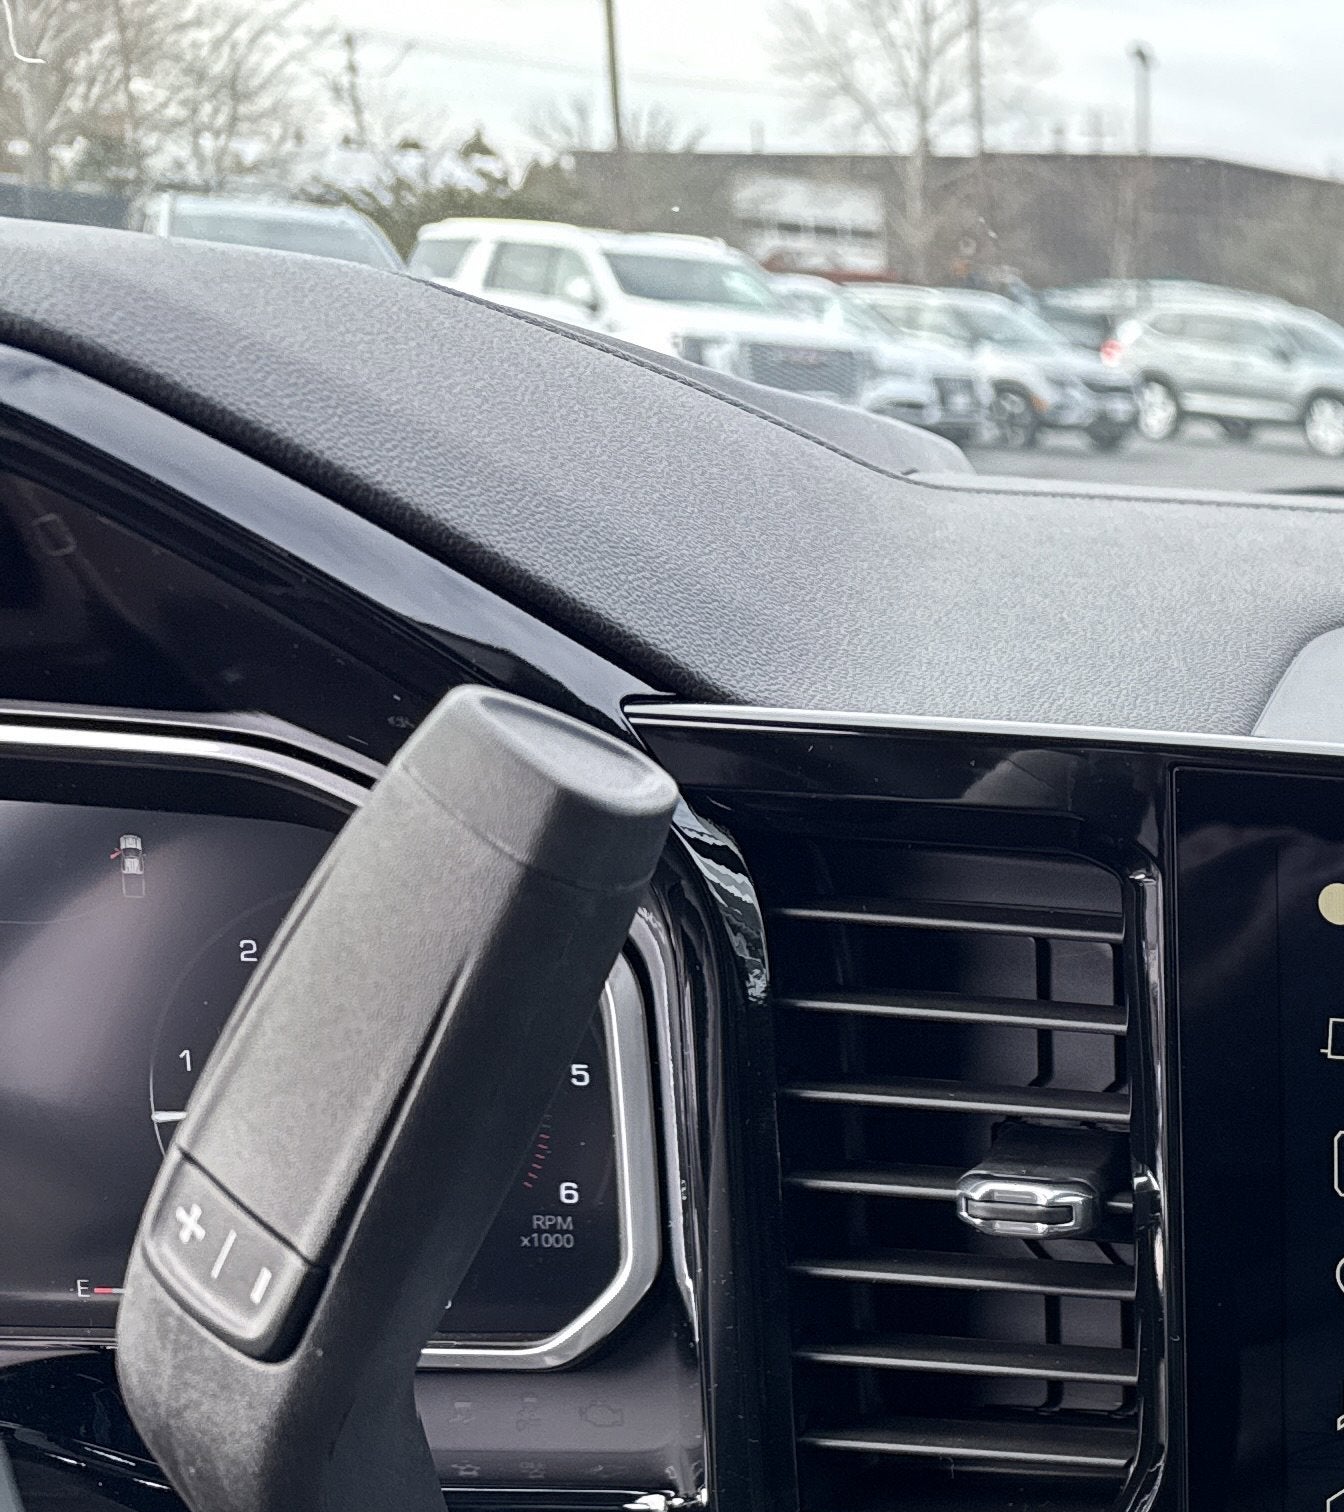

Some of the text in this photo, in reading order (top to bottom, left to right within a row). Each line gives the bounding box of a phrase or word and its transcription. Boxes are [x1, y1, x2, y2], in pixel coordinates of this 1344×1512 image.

[238, 939, 258, 962] 2
[178, 1049, 192, 1072] 1
[570, 1063, 590, 1087] 5
[559, 1181, 579, 1204] 6
[532, 1214, 574, 1231] RPM
[520, 1232, 575, 1249] x1000
[75, 1279, 91, 1298] E
